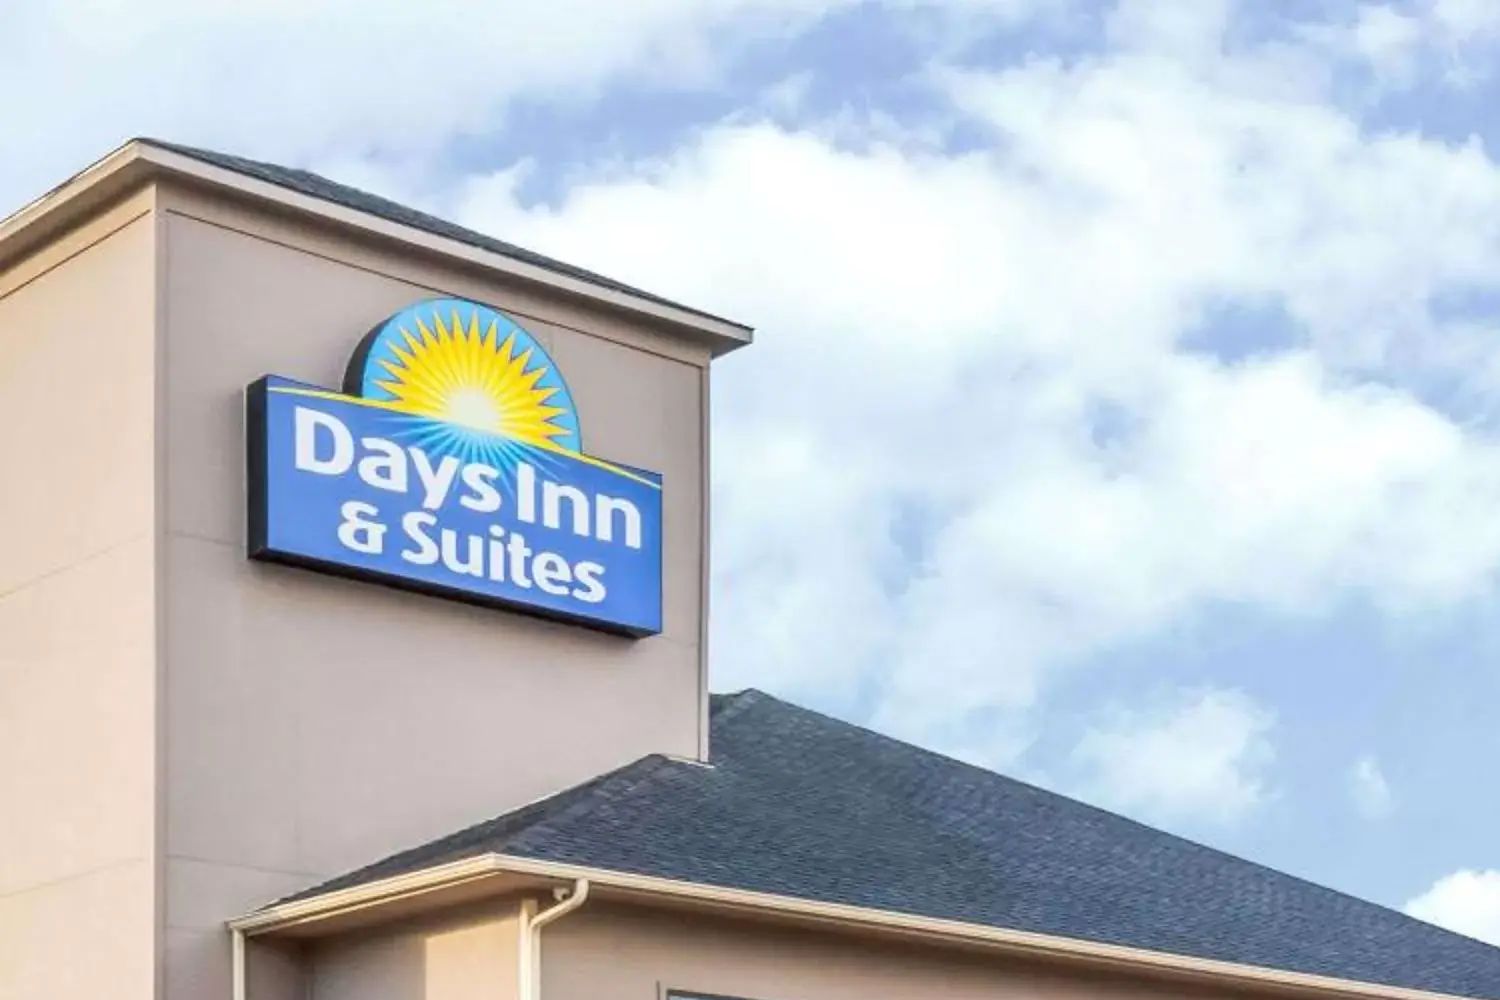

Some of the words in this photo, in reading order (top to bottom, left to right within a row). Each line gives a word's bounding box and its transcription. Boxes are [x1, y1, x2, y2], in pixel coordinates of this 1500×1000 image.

[295, 407, 502, 511] Days
[517, 463, 642, 550] Inn
[338, 501, 388, 554] &
[402, 512, 608, 603] Suites
